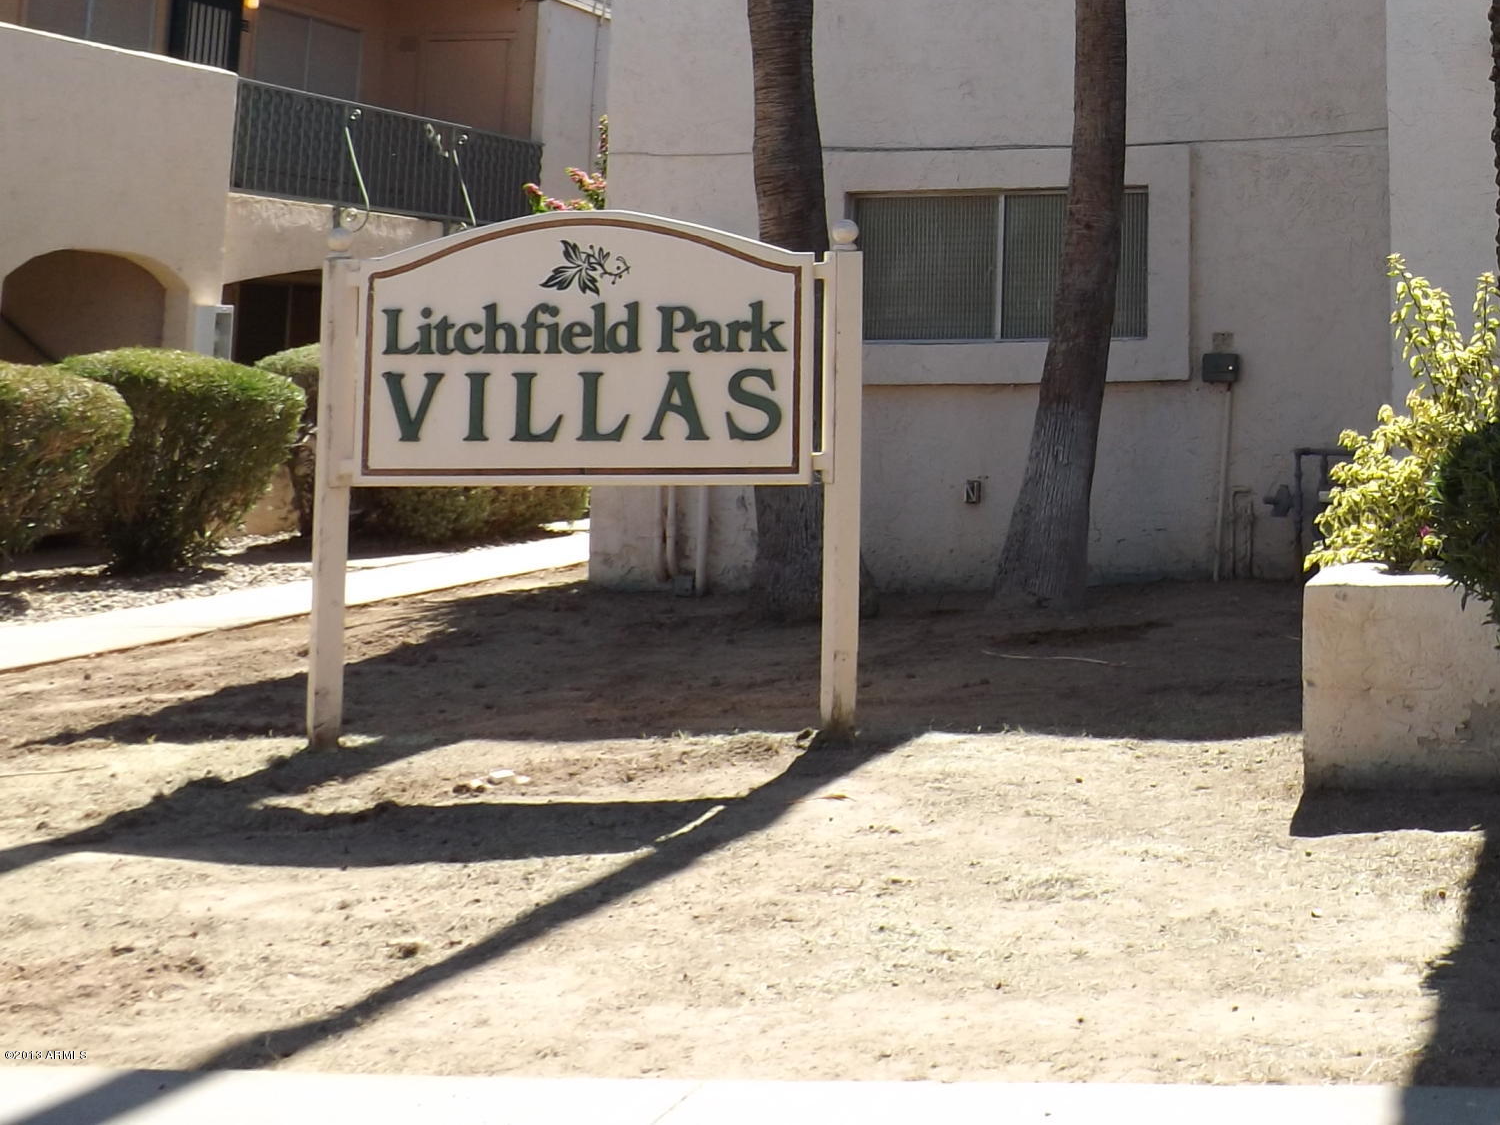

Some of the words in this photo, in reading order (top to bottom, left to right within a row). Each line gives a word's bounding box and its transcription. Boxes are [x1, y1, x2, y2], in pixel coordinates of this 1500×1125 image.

[382, 302, 640, 355] Litchfield
[656, 301, 787, 353] Park
[382, 368, 784, 442] VILLAS
